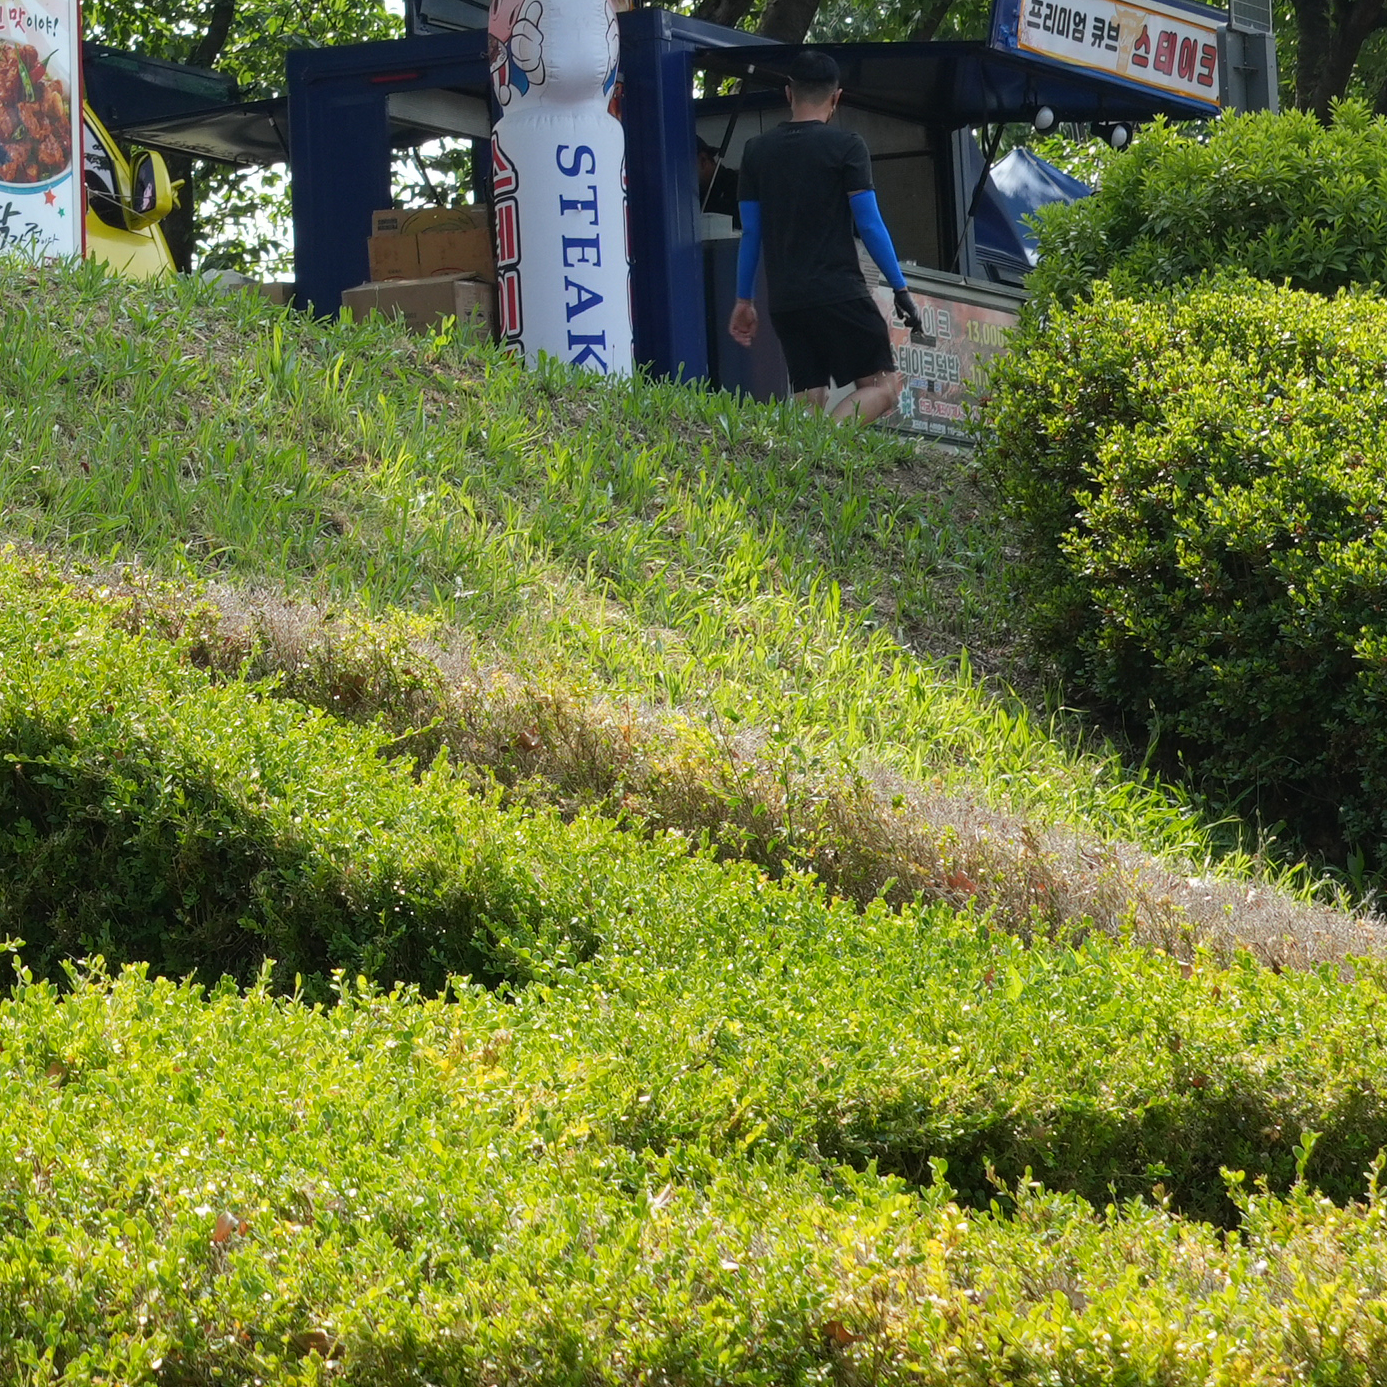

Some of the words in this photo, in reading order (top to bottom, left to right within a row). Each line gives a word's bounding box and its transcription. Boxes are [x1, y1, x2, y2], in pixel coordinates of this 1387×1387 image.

[1091, 16, 1120, 52] 큐브
[1131, 25, 1217, 88] 스테이크
[555, 144, 608, 375] STEAK
